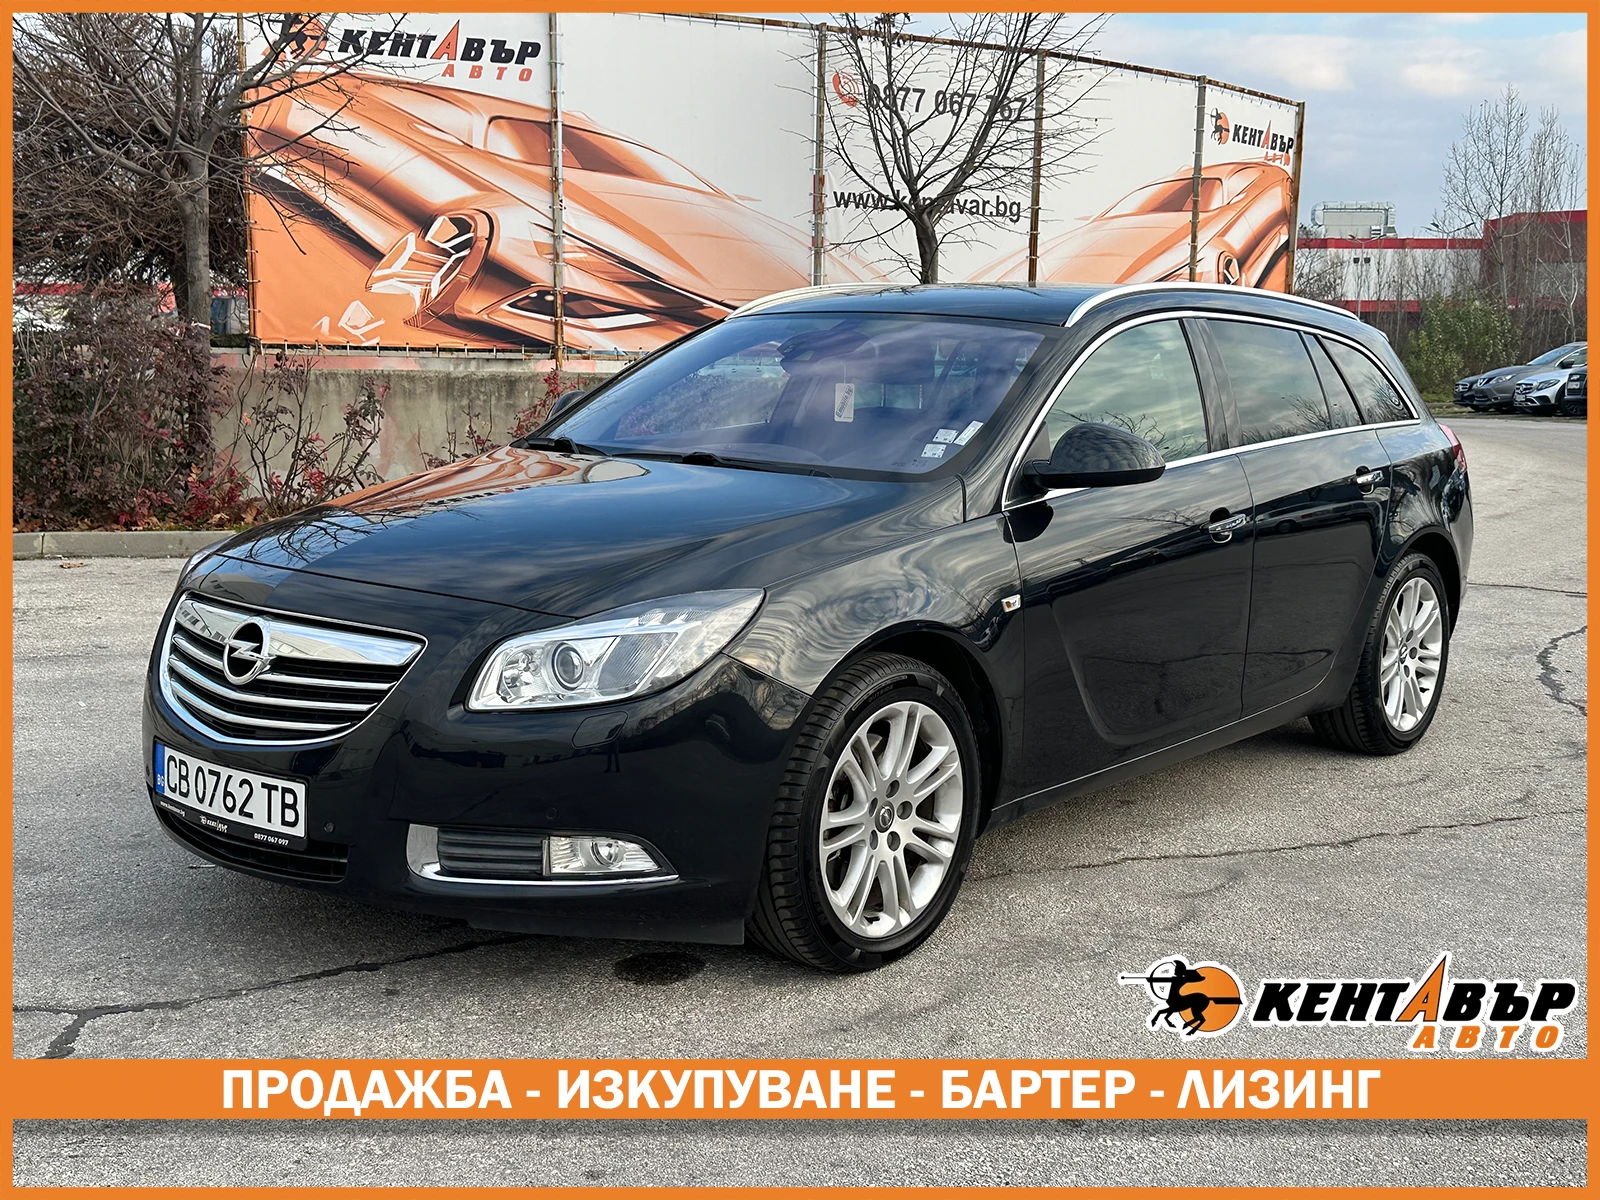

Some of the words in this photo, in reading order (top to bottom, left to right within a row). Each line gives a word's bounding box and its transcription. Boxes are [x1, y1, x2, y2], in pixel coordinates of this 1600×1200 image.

[337, 19, 542, 66] КЕНТАВЪР
[441, 63, 533, 82] АВТО
[935, 89, 977, 118] 067
[1232, 120, 1294, 154] КЕНТАВЪР
[157, 774, 165, 787] BG
[194, 765, 254, 820] 0762
[267, 835, 278, 843] 067
